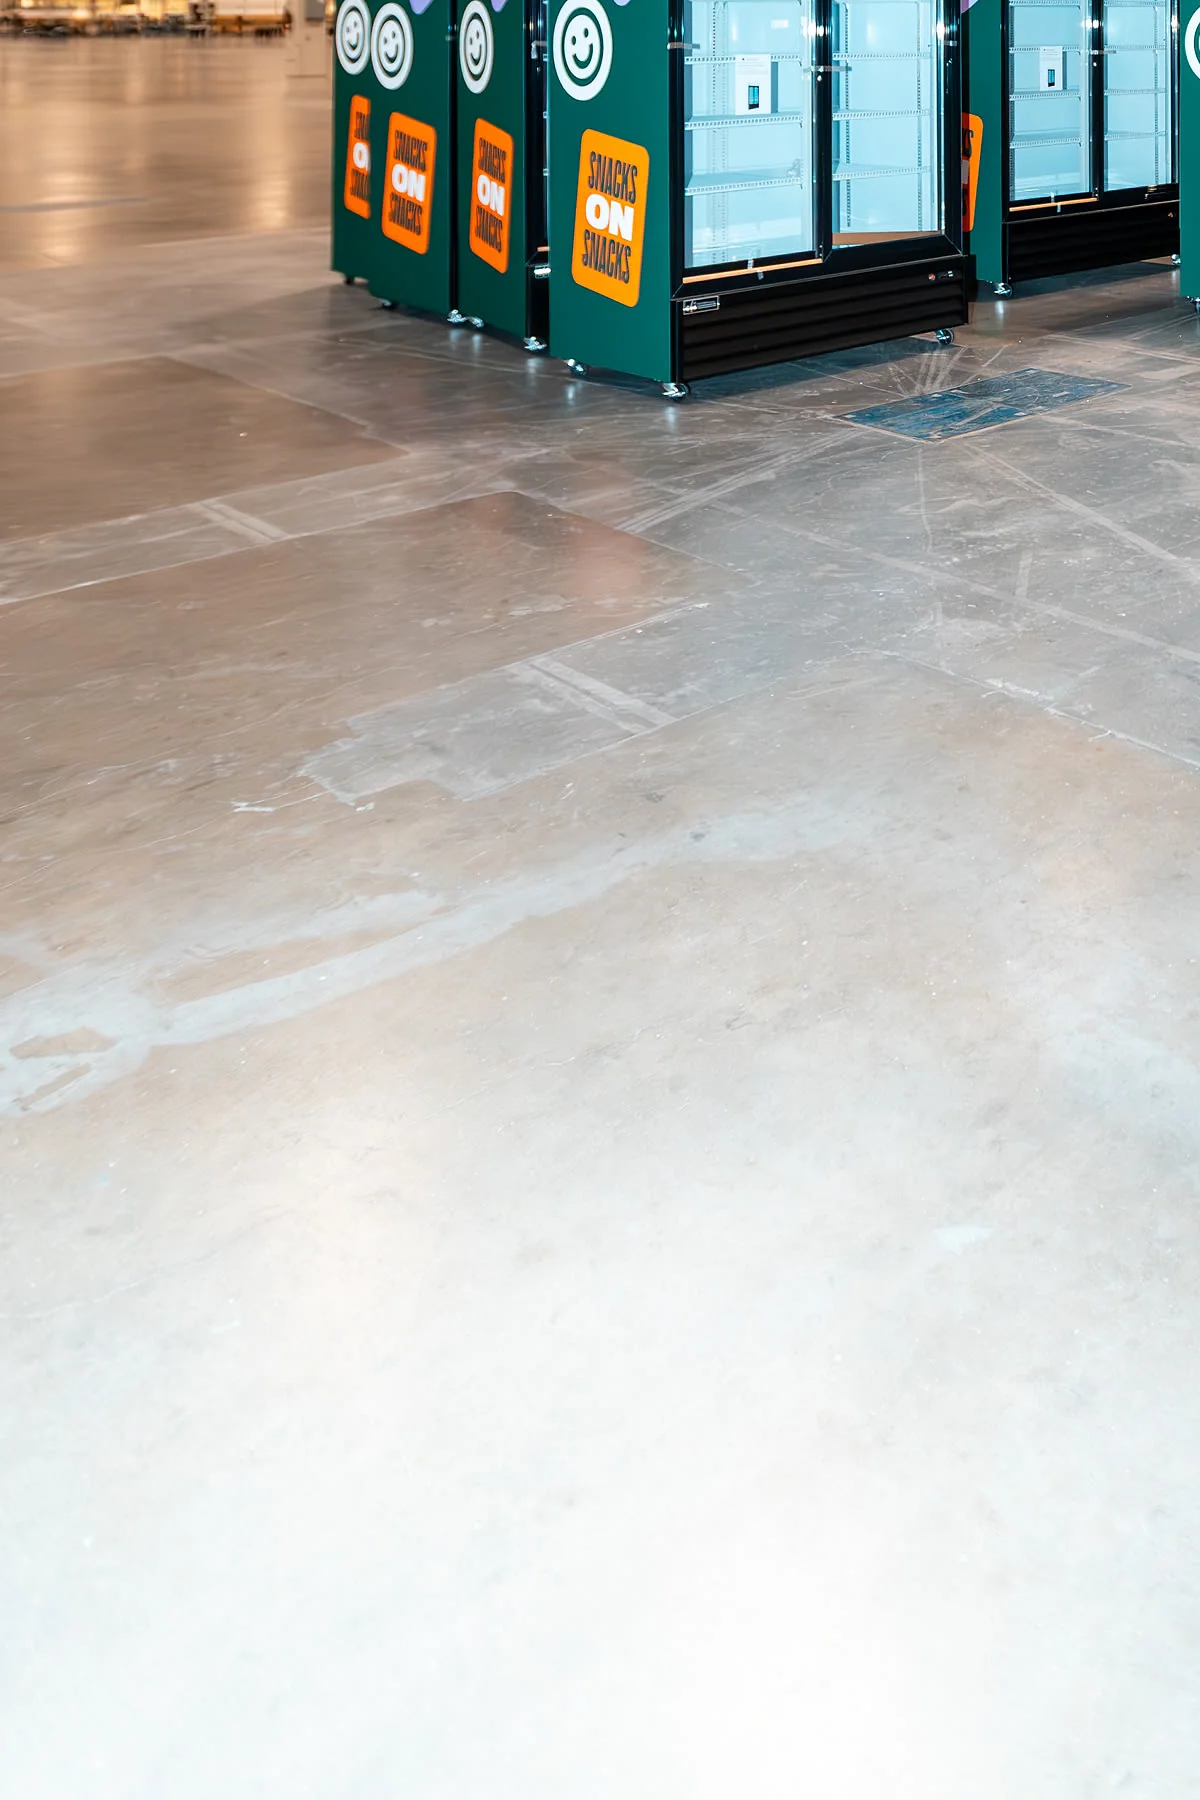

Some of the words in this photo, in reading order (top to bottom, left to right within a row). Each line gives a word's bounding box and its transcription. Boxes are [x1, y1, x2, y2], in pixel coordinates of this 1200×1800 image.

[394, 129, 428, 172] SNACKS
[391, 163, 426, 202] ON
[477, 174, 505, 216] ON
[588, 151, 638, 204] SNACKS
[585, 193, 634, 241] ON
[582, 229, 631, 284] SNACKS
